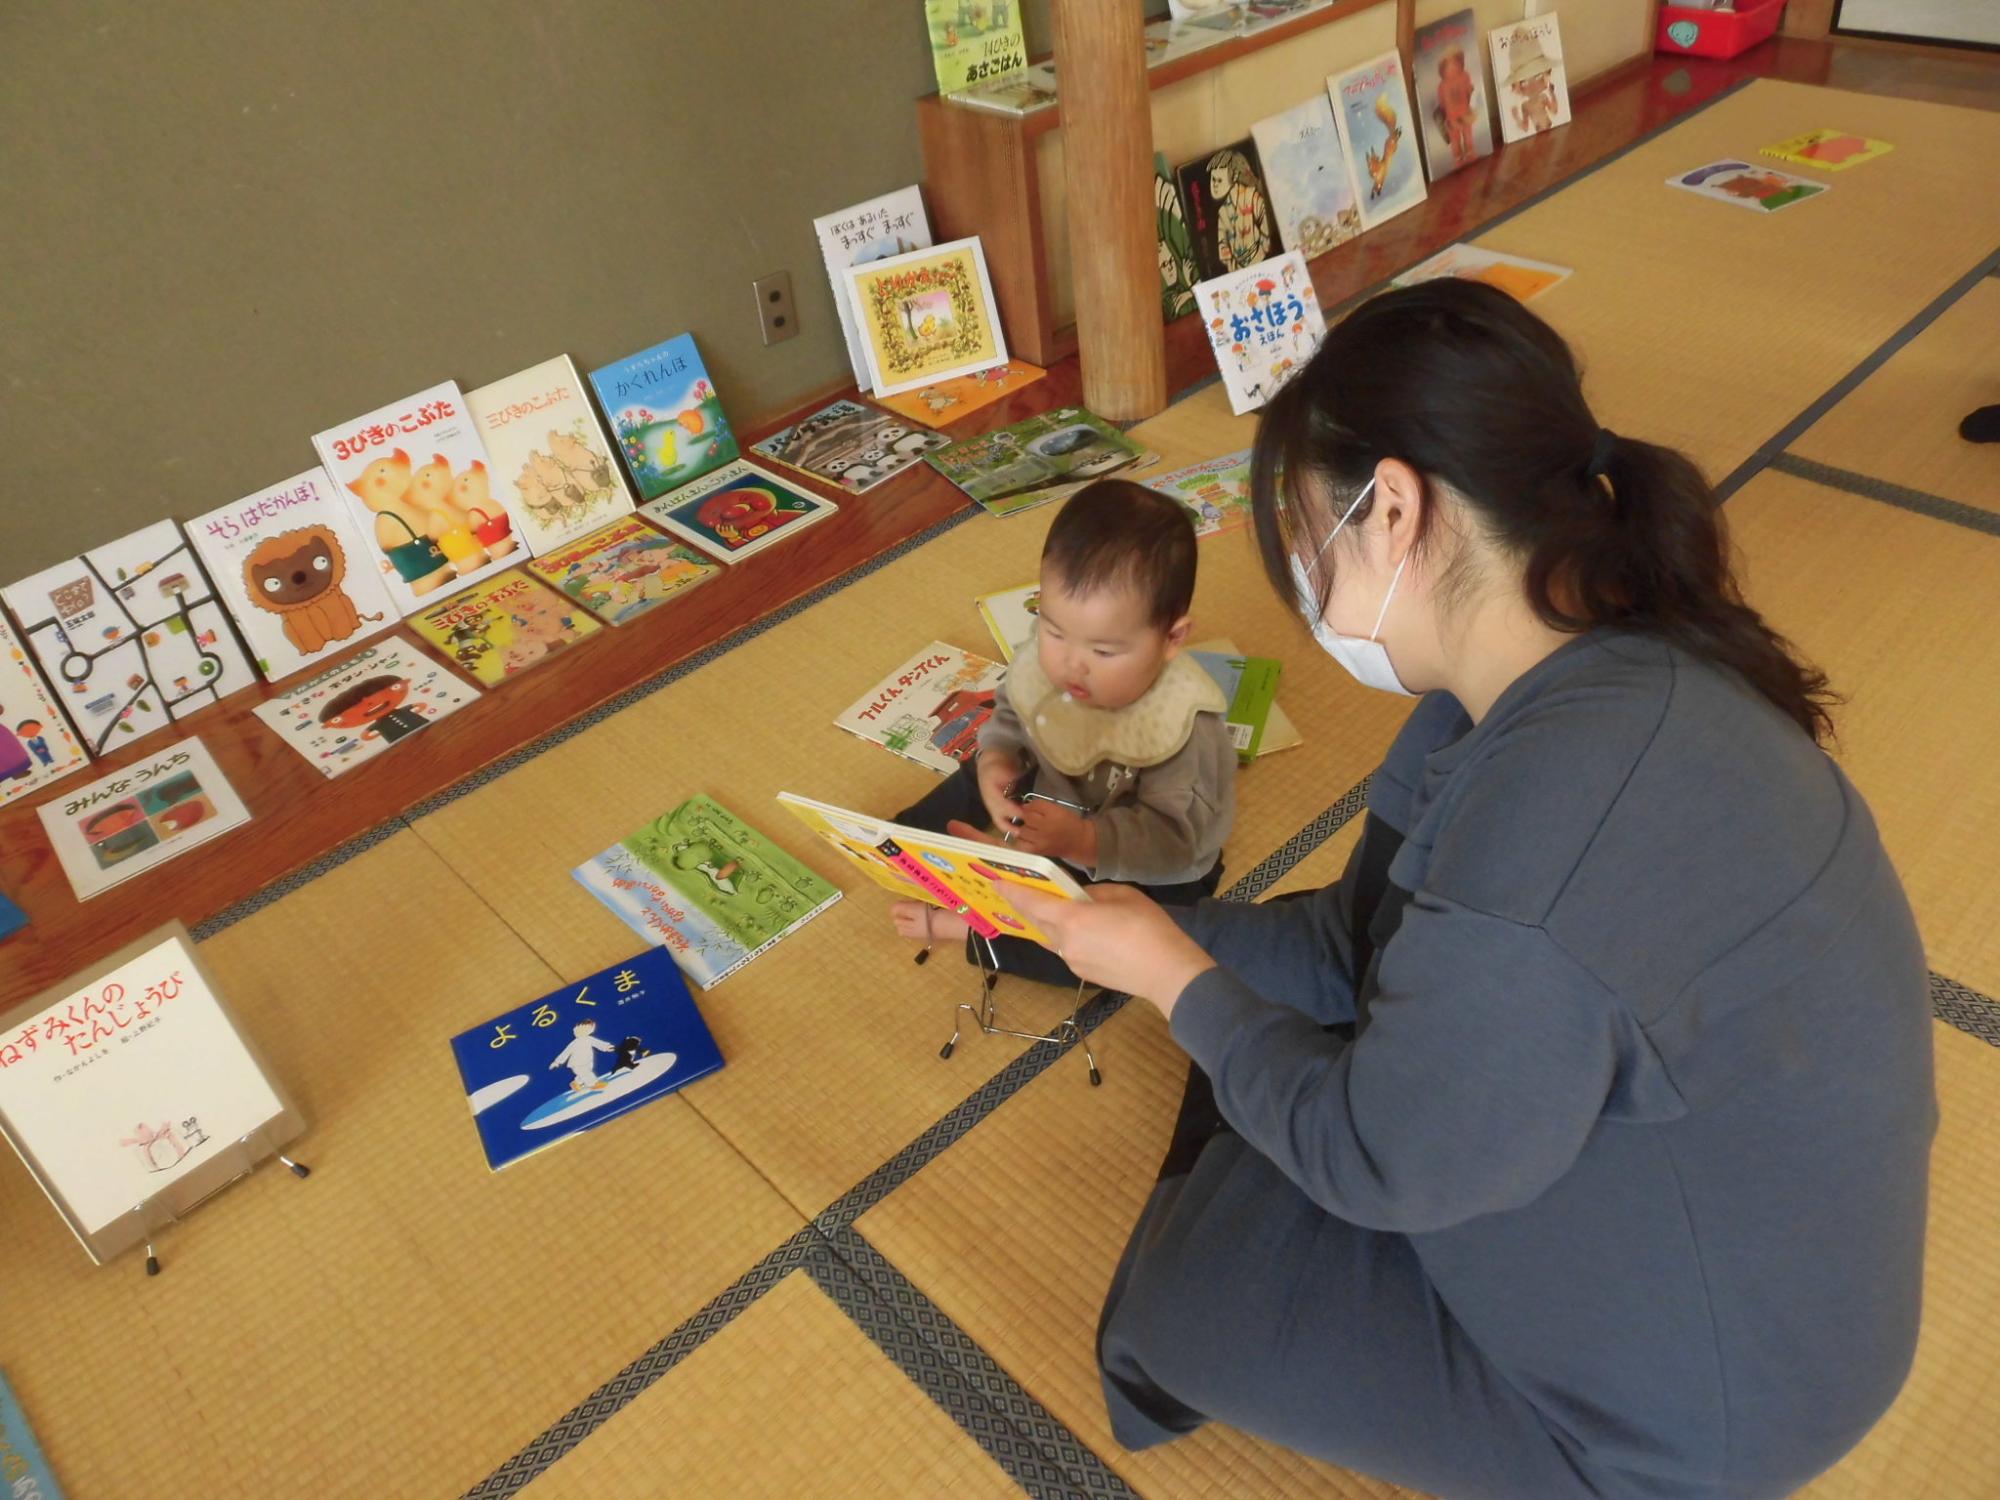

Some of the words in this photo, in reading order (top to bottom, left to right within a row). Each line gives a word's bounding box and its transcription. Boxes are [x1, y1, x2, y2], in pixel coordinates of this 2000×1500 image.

[966, 52, 1022, 82] あさごはん
[1230, 293, 1303, 342] おさほう
[332, 400, 456, 461] 3びきのこぶた
[486, 386, 571, 430] 三びきのこぶた
[0, 983, 125, 1068] ねずみくんの
[64, 971, 184, 1056] たんじょうび
[490, 970, 641, 1049] よるくま
